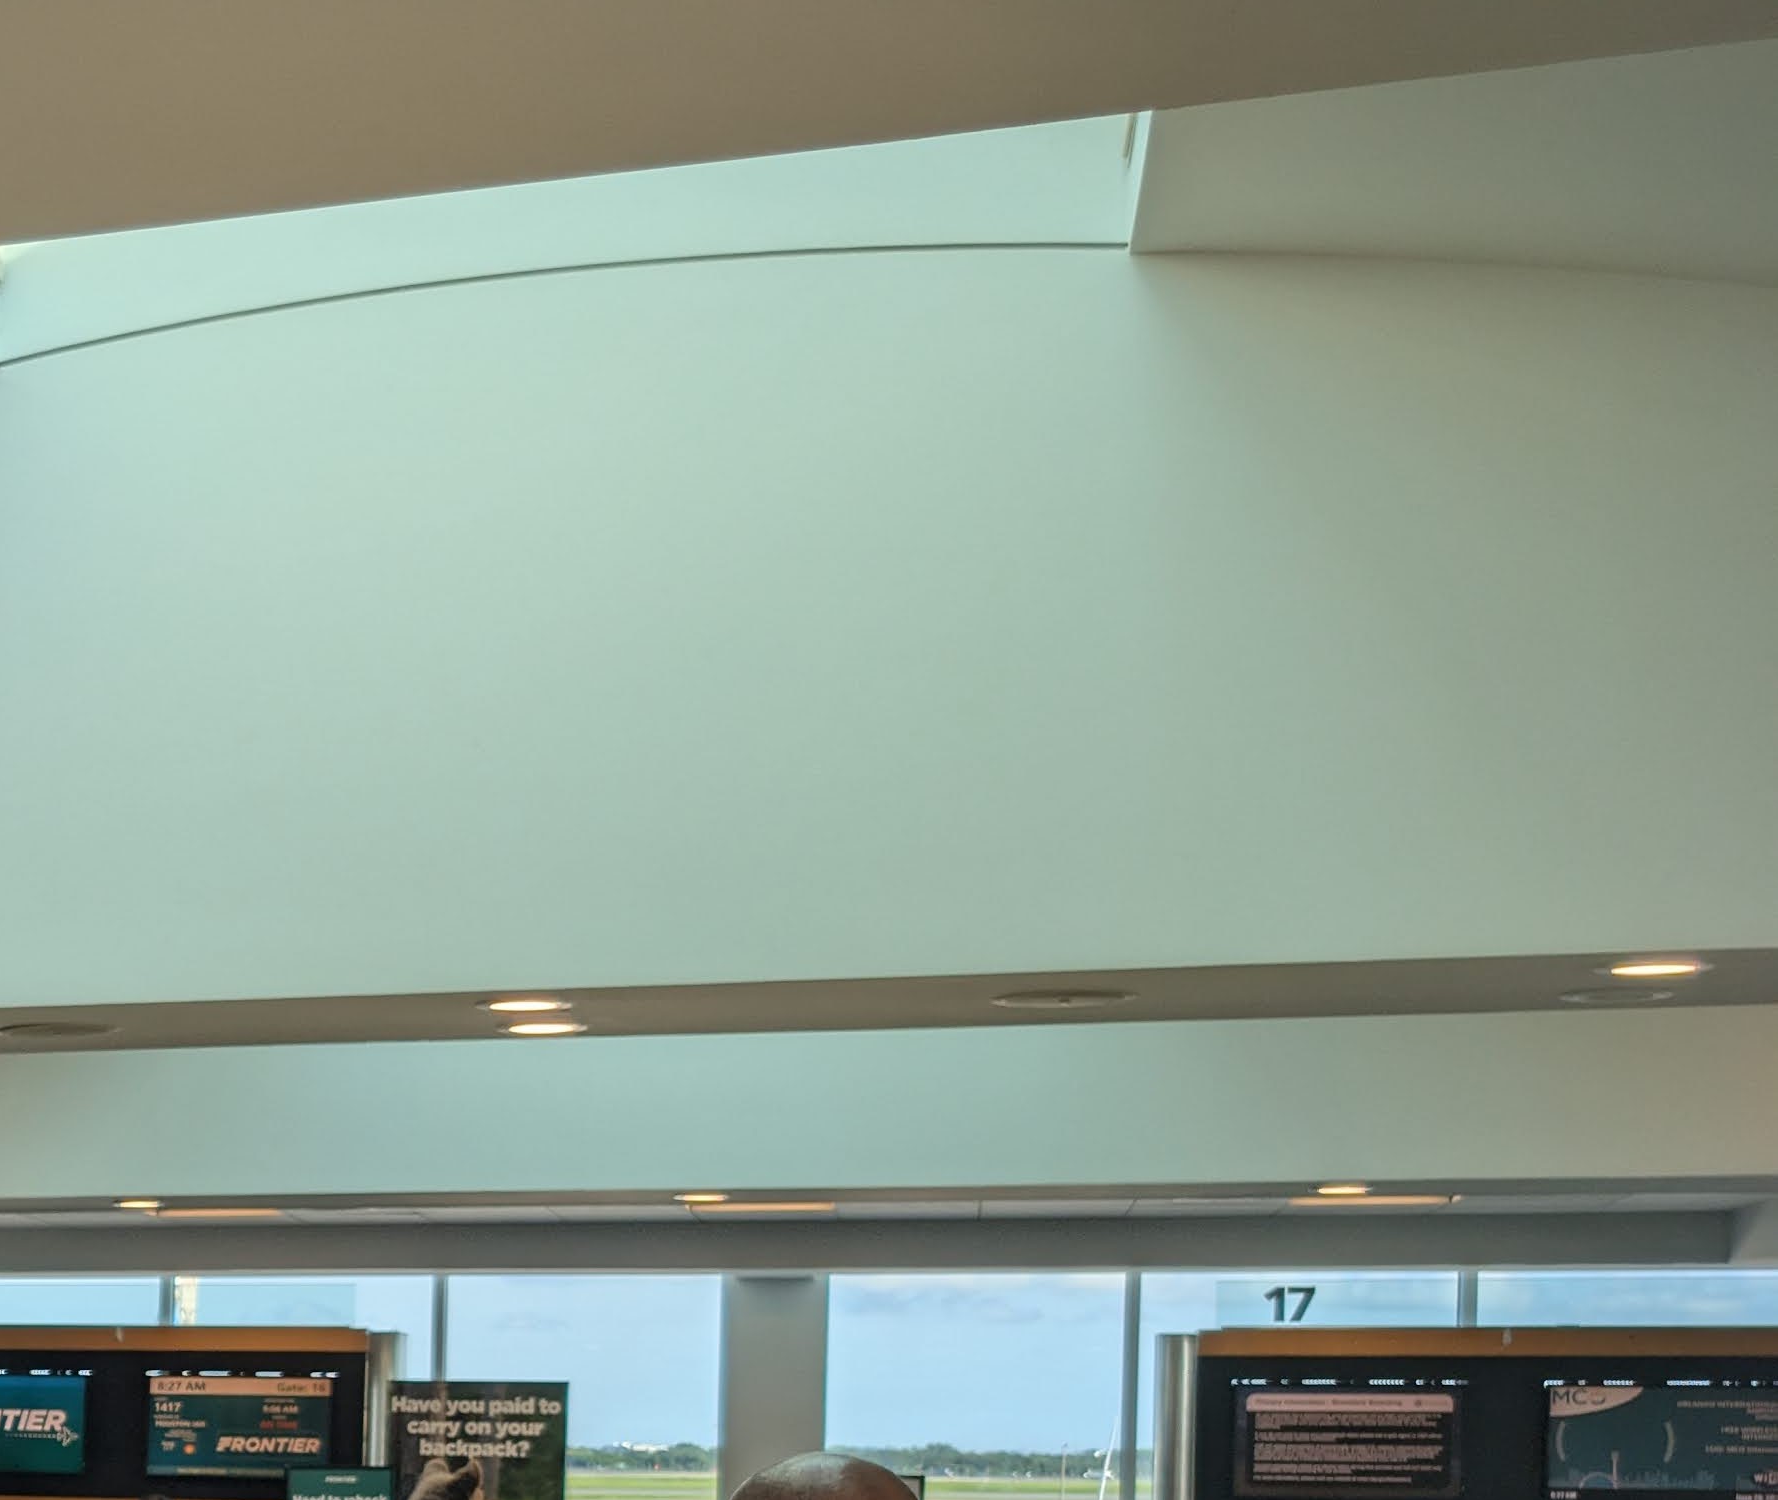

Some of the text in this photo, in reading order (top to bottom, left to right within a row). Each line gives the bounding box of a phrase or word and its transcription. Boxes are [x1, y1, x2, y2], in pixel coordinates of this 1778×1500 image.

[1263, 1287, 1315, 1321] 17
[186, 1382, 205, 1391] AM
[155, 1402, 181, 1412] 1417
[391, 1395, 561, 1417] Have you paid to
[407, 1420, 544, 1438] carry on your
[216, 1437, 321, 1453] FRONTIER
[419, 1439, 531, 1458] backpack?
